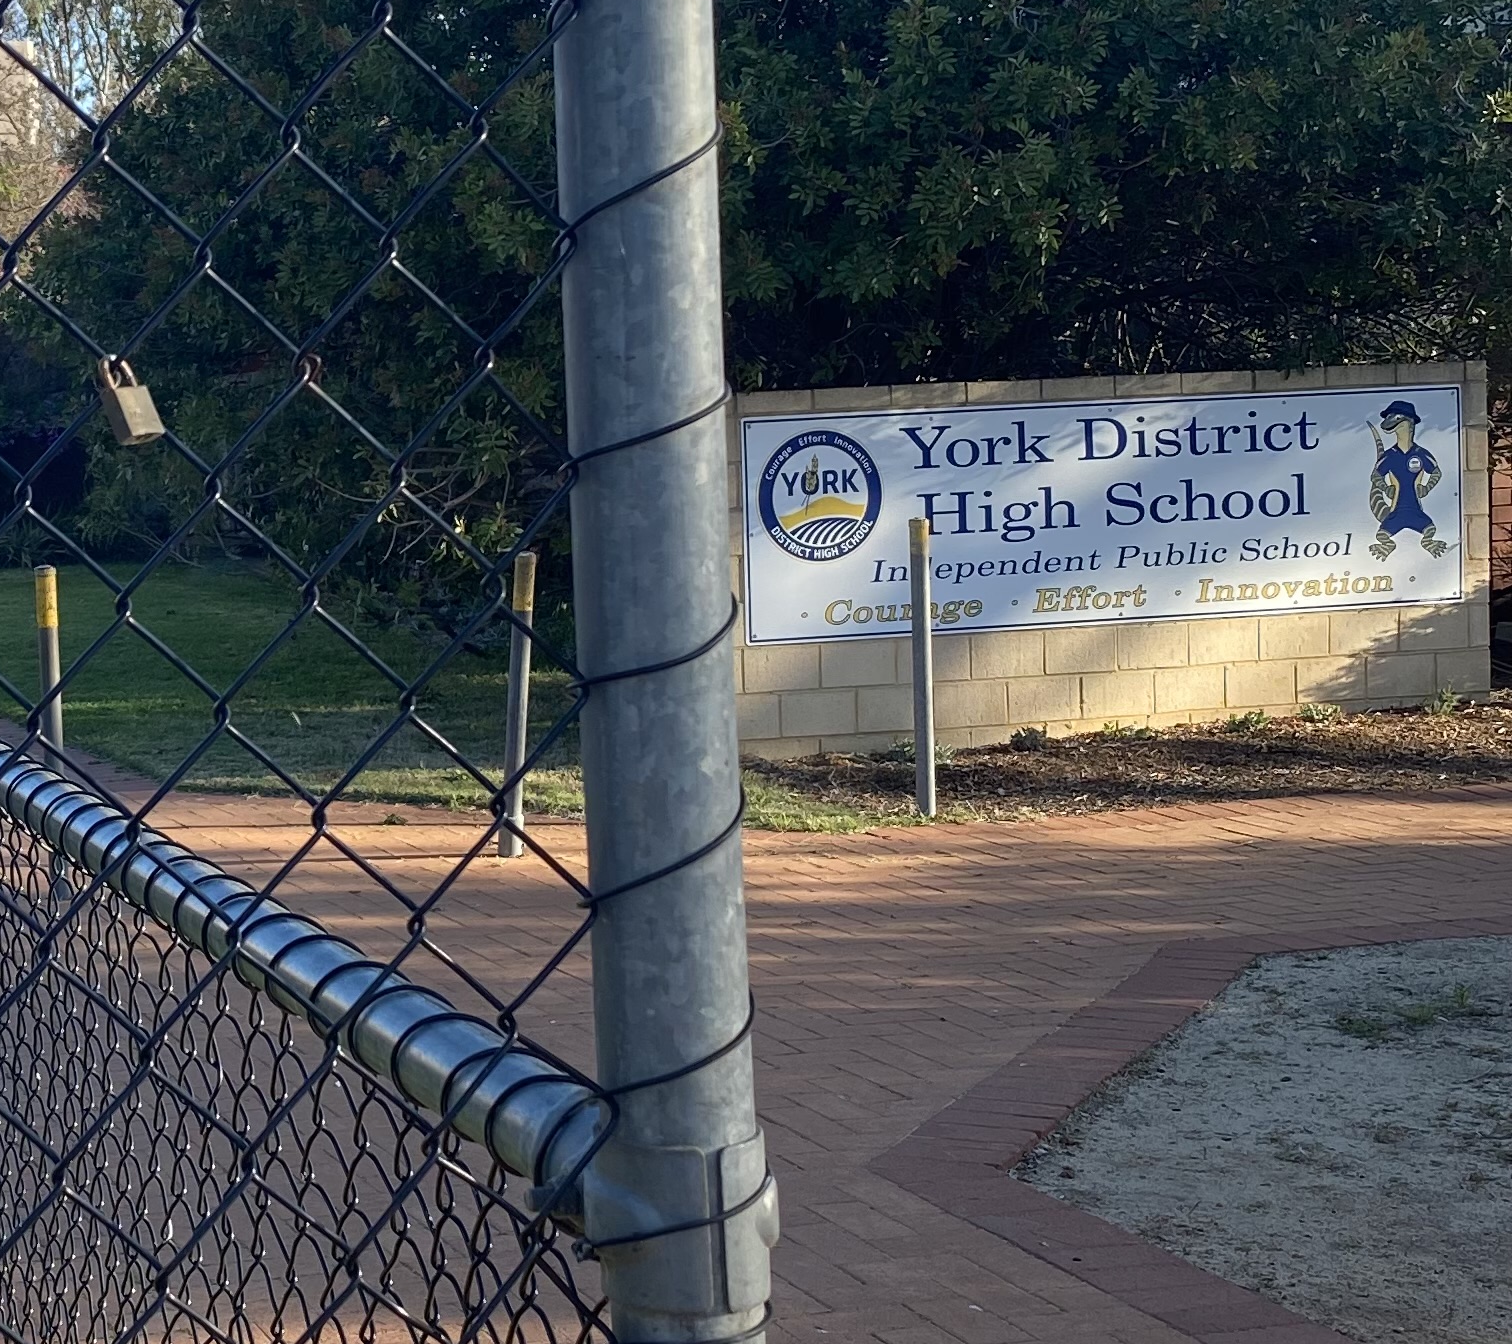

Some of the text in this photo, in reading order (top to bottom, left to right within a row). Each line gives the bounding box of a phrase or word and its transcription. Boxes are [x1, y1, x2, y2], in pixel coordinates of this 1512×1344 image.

[765, 434, 873, 481] Courage Effort Innovation
[899, 410, 1320, 469] York District
[781, 469, 860, 496] YORK
[917, 472, 1310, 542] High School
[770, 520, 874, 560] DISTRICT HIGH SCHOOL
[870, 533, 1353, 585] Inependent Public School
[1032, 584, 1147, 613] Effort
[1195, 570, 1394, 604] Innovation
